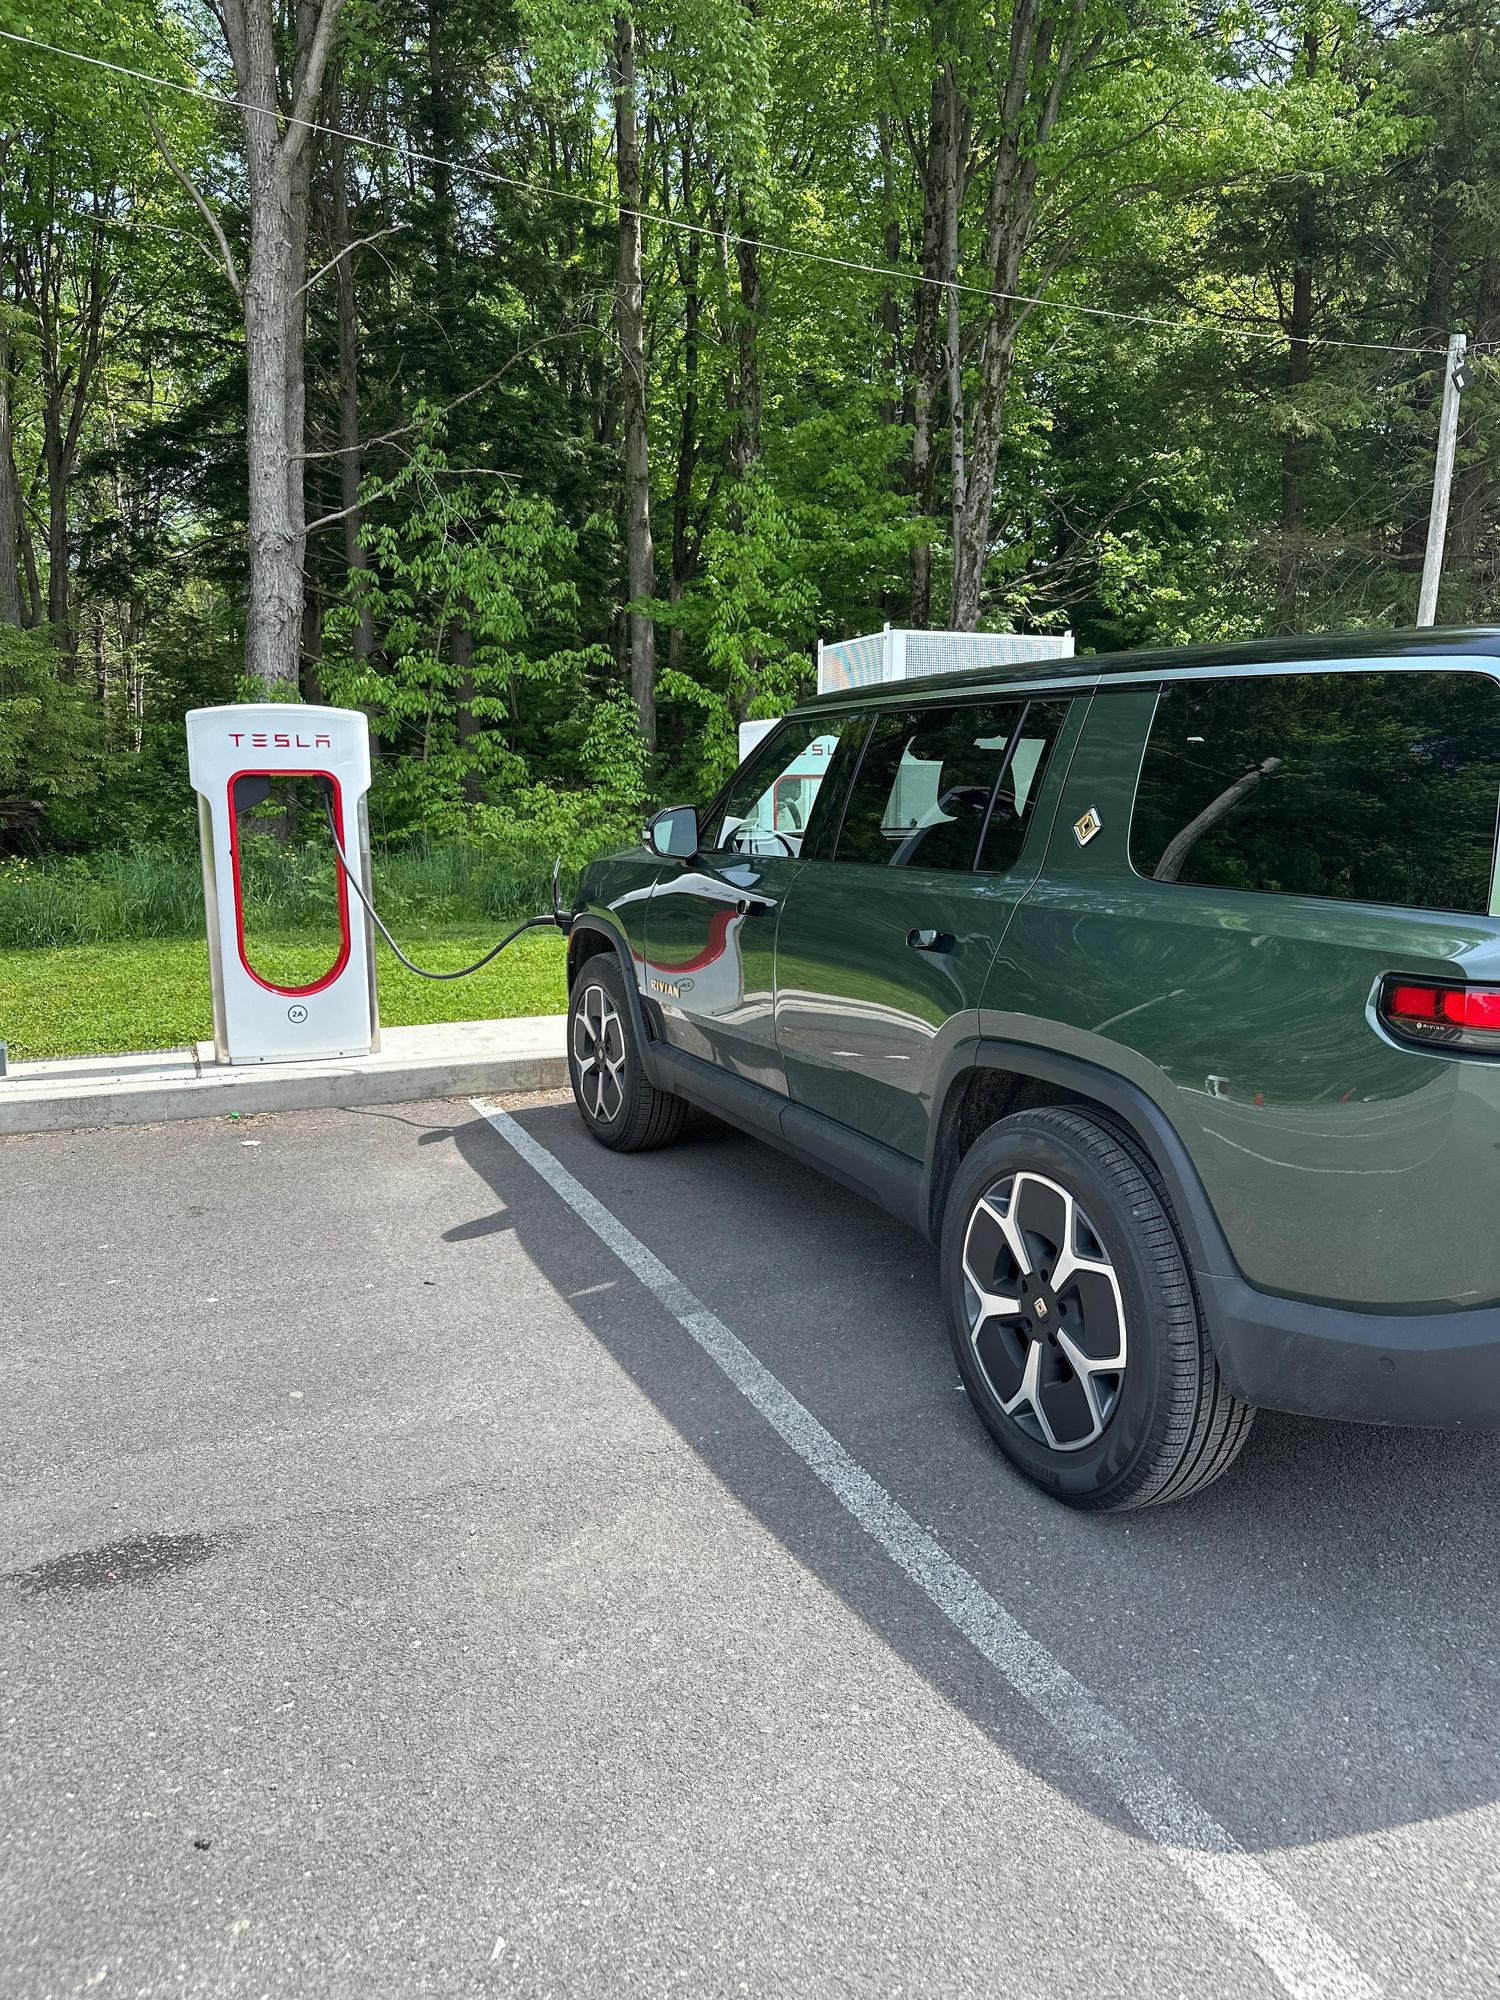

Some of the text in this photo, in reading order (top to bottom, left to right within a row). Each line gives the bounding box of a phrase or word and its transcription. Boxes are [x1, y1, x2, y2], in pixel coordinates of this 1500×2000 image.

[228, 733, 330, 748] TESLA
[651, 979, 680, 998] RIVIAN
[292, 1010, 304, 1018] 2A
[1423, 1023, 1446, 1031] RIVIAN
